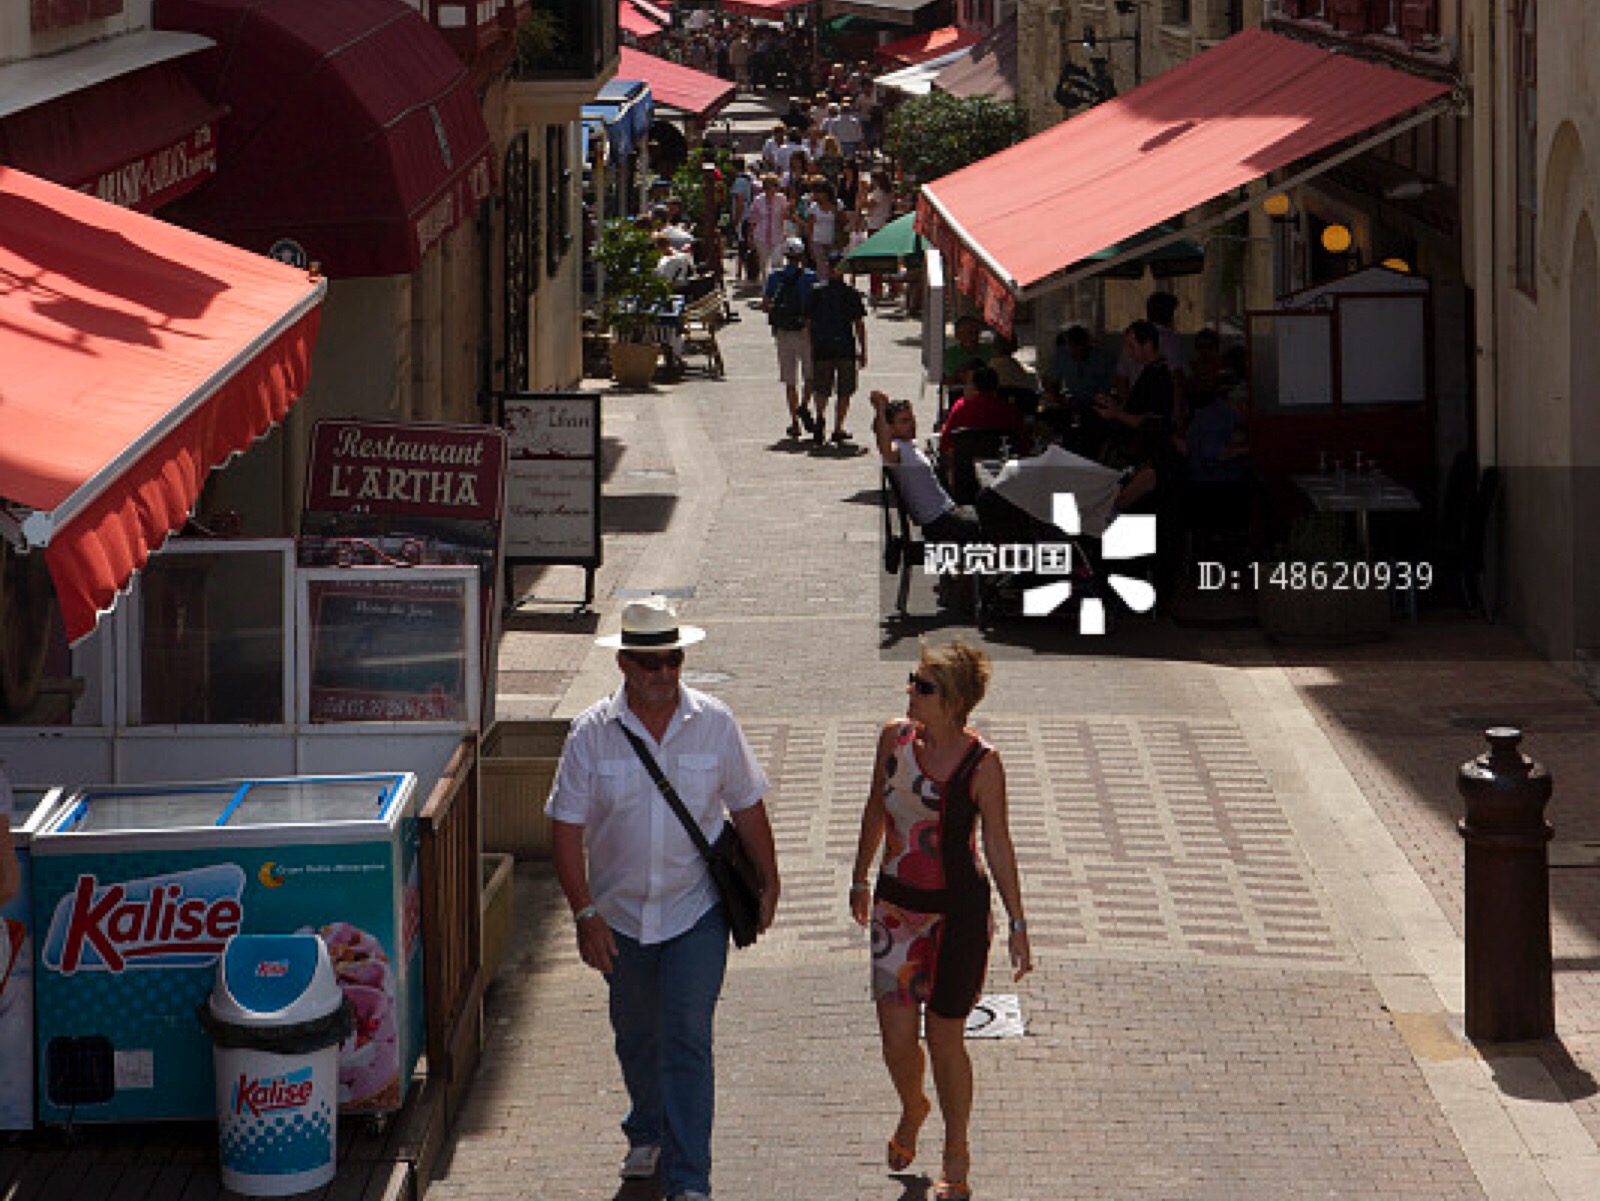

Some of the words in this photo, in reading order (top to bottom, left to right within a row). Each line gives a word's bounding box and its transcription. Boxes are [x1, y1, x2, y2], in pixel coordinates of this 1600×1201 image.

[332, 426, 483, 467] Restaurant
[330, 465, 479, 507] L'ARTHA
[60, 875, 242, 973] Kalise
[236, 1072, 313, 1118] Kalise
